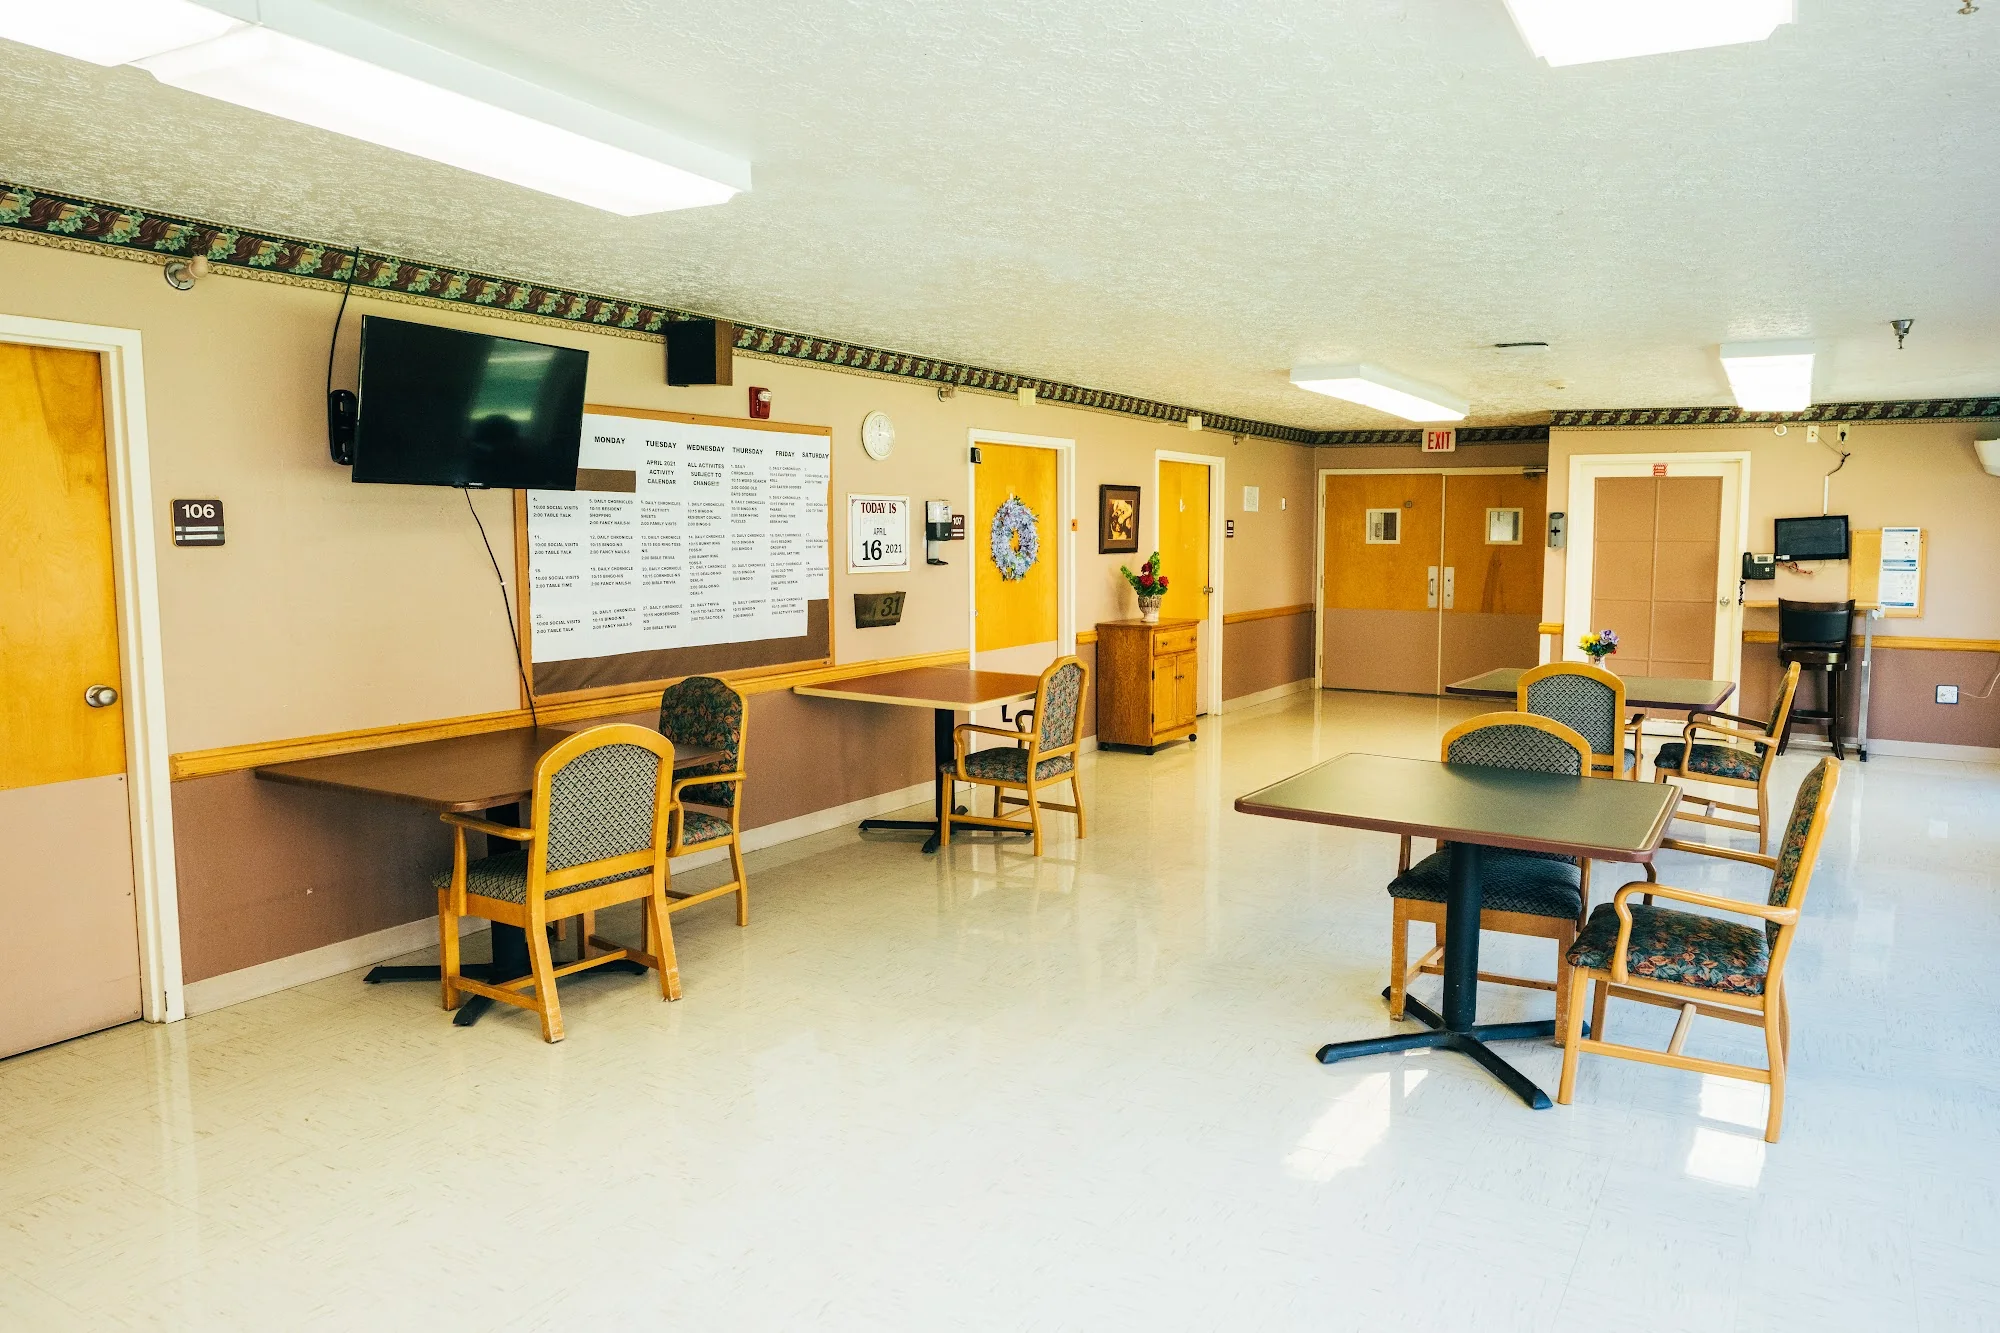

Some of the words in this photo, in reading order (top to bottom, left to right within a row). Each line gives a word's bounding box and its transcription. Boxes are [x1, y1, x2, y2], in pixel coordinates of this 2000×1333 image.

[594, 436, 626, 444] MONDAY
[645, 440, 677, 449] TUESDAY
[686, 444, 725, 453] WEDNESDAY
[732, 446, 764, 455] THURSDAY
[1427, 431, 1452, 450] EXIT
[182, 504, 215, 519] 106
[861, 502, 887, 514] TODAY
[888, 503, 897, 514] IS
[953, 516, 962, 525] 107
[873, 527, 887, 536] APRIL
[862, 540, 882, 561] 16
[885, 544, 902, 554] 2021
[881, 596, 901, 617] 31
